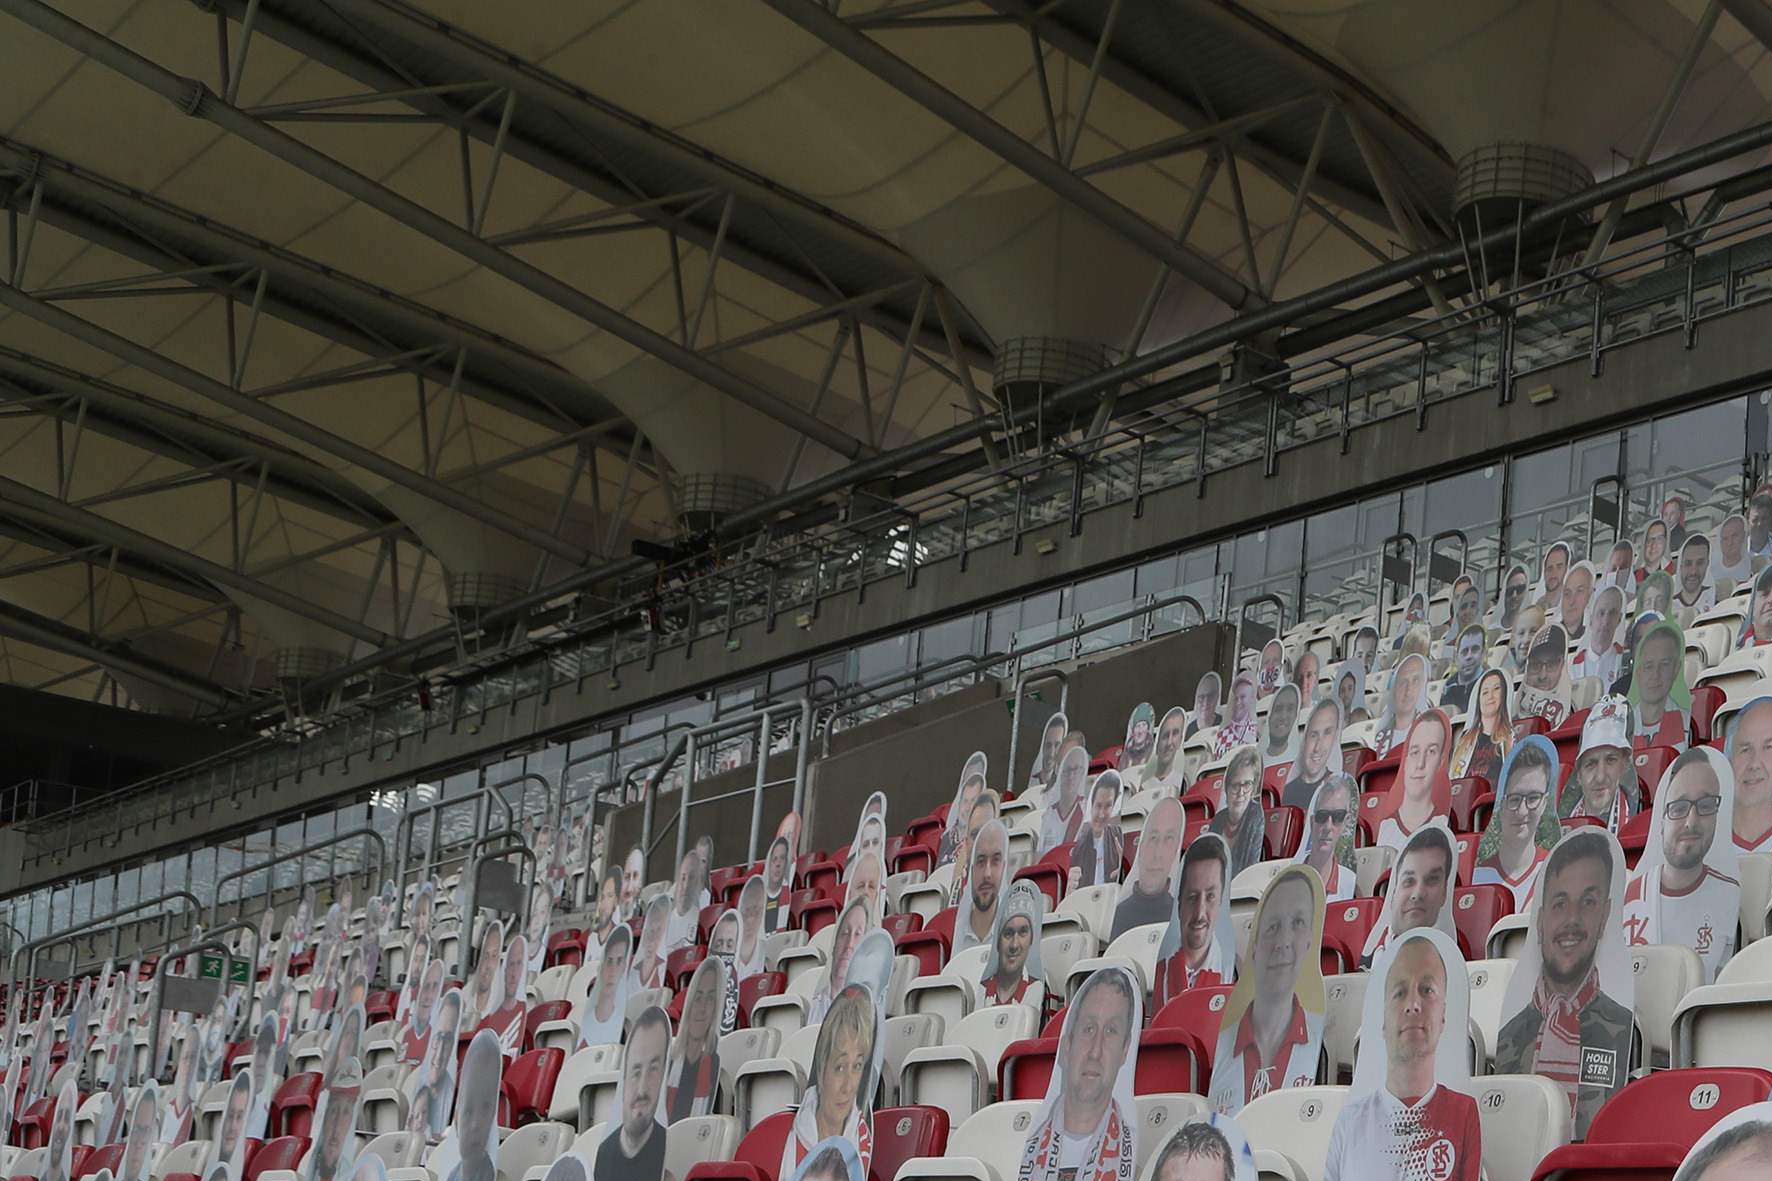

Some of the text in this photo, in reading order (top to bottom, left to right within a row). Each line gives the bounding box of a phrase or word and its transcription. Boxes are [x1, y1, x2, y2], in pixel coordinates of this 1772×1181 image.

[1633, 962, 1640, 972] 9
[1476, 975, 1482, 985] 8
[1586, 1053, 1611, 1064] HOLLI
[1587, 1064, 1608, 1076] STER
[1488, 1094, 1500, 1107] 10
[1697, 1090, 1712, 1104] 11
[1307, 1105, 1314, 1117] 9
[1154, 1112, 1161, 1123] 8
[901, 1121, 908, 1131] 6
